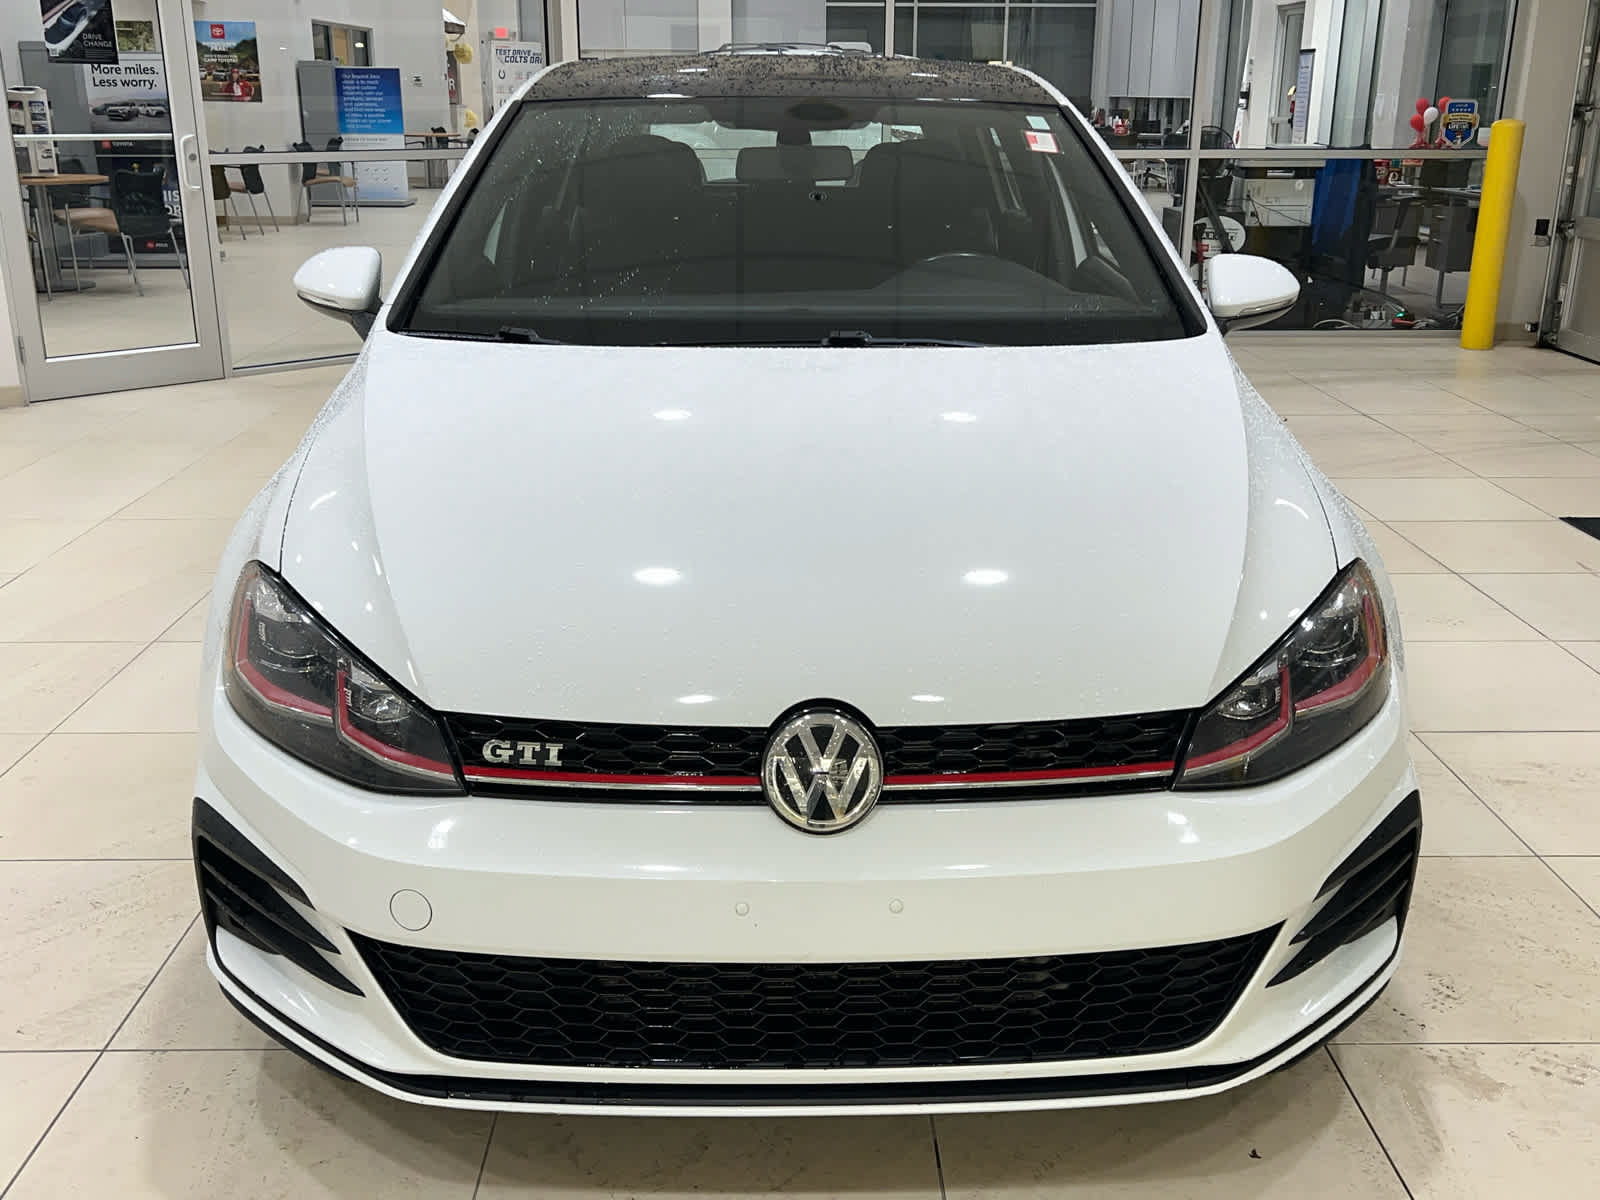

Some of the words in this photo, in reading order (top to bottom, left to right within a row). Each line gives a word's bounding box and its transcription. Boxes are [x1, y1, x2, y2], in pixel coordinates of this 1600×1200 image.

[495, 48, 511, 56] TEST
[504, 55, 529, 64] COLTS
[91, 63, 121, 75] More
[124, 63, 159, 75] miles.
[92, 79, 118, 88] Less
[120, 79, 158, 90] worry.
[482, 739, 564, 767] GTI
